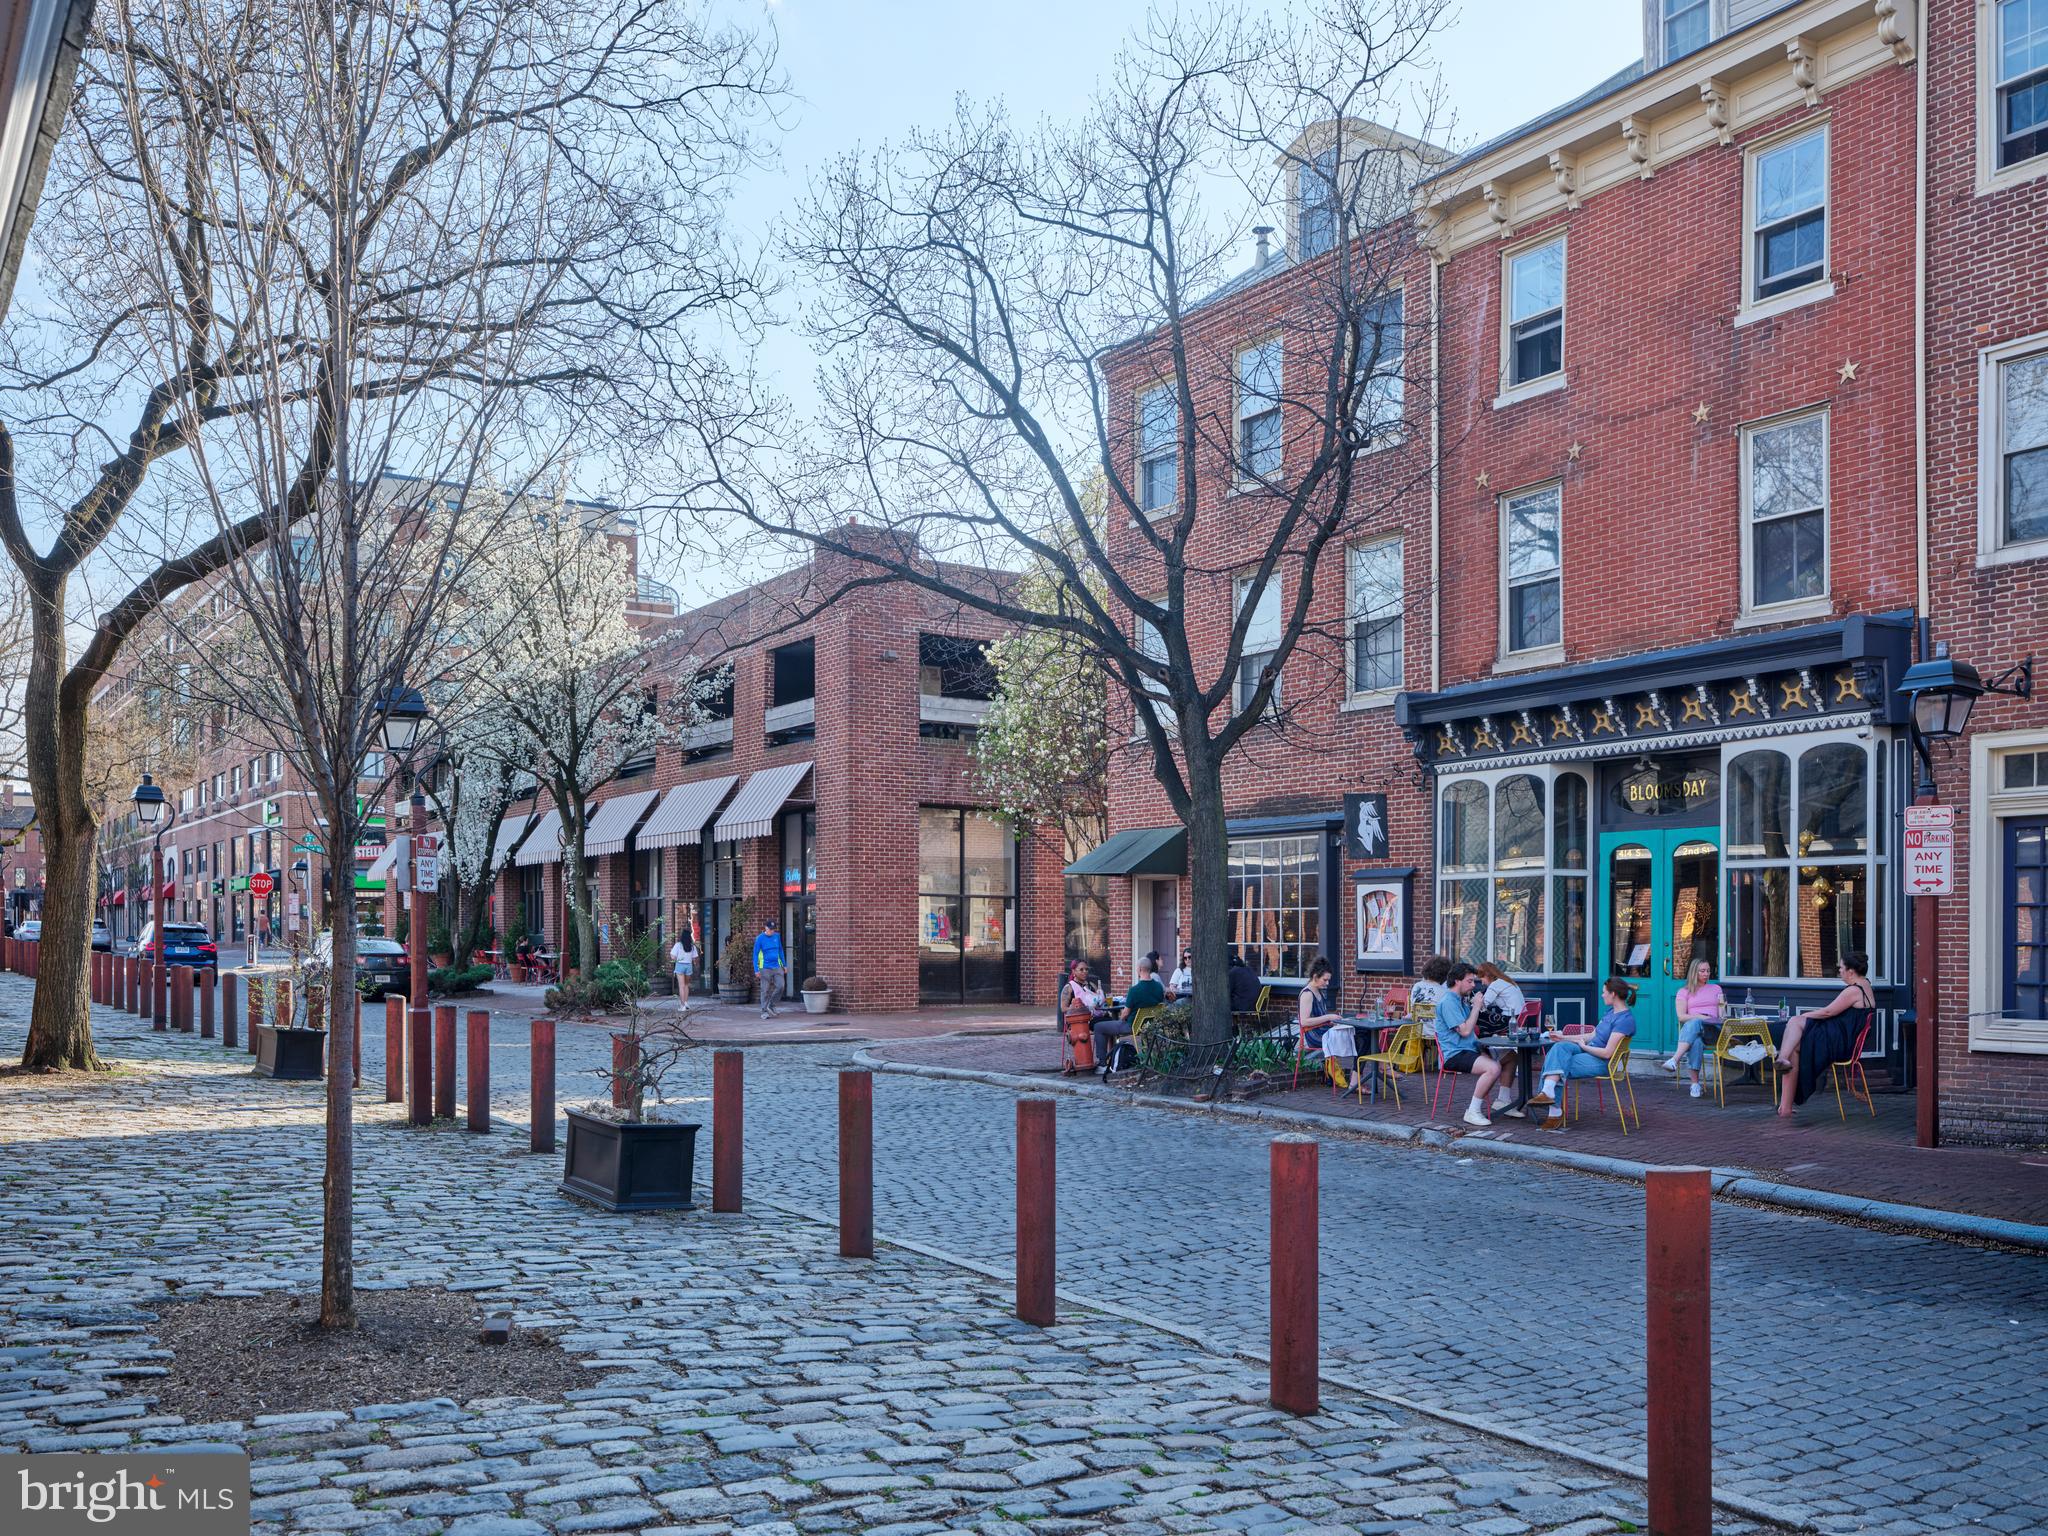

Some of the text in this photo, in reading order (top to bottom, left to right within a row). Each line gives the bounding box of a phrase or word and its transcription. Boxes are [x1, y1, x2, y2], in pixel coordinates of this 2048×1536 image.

[1630, 778, 1707, 801] BLOOMSDAY
[1907, 832, 1950, 846] NO PARKING
[355, 846, 383, 858] STELLA
[1618, 850, 1632, 858] 414
[1683, 847, 1699, 855] 2nd
[1915, 852, 1943, 861] ANY
[420, 859, 434, 868] ANY
[420, 869, 434, 878] TIME
[1914, 865, 1943, 874] TIME
[250, 878, 272, 889] STOP
